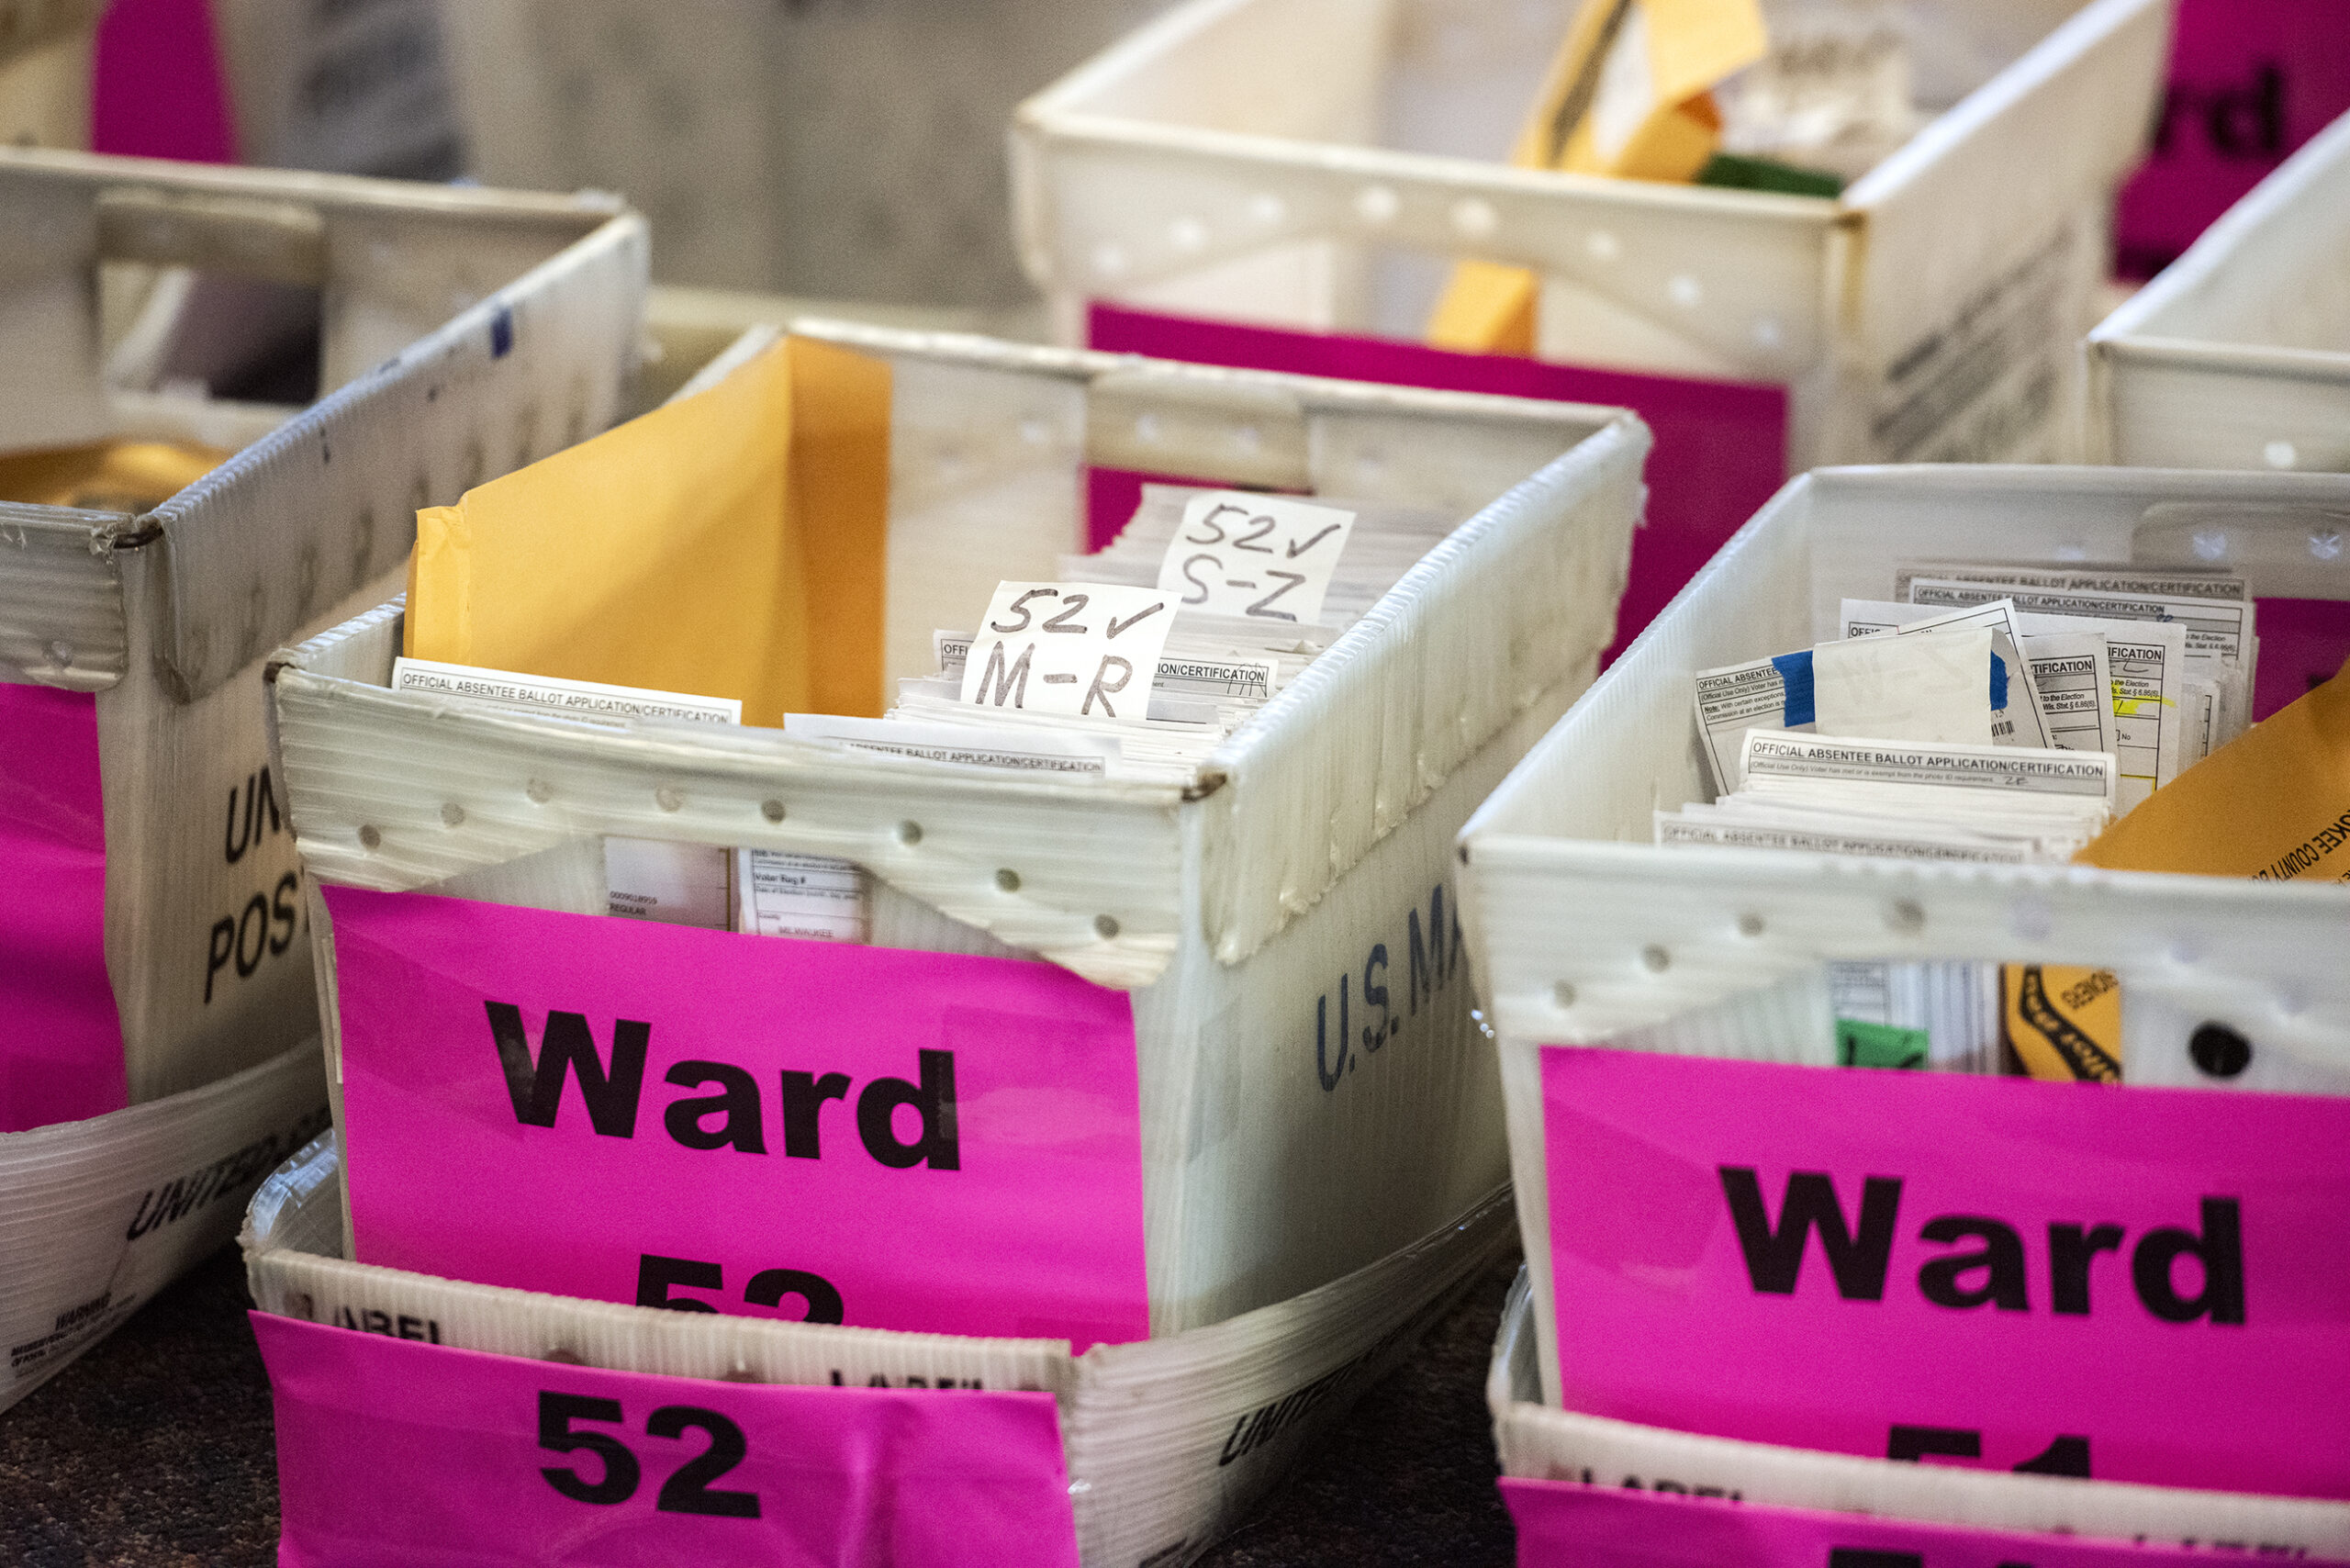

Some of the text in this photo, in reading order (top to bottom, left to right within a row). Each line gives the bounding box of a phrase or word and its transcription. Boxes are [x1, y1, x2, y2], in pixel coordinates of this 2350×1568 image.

[1185, 503, 1274, 554] 52
[1917, 586, 1955, 599] OFFICIAL
[990, 588, 1088, 633] 52
[974, 640, 1135, 719] M-R
[1698, 667, 1778, 689] OFFICIAL ABSENTEE
[2031, 660, 2093, 674] TIFICATION
[403, 672, 453, 690] OFFICIAL
[456, 680, 516, 699] ABSENTEE
[519, 689, 565, 704] BALLOT
[1751, 682, 1767, 691] Voter
[905, 747, 948, 761] BALLOT
[2121, 733, 2132, 741] No
[1752, 742, 2104, 777] OFFICIAL ABSENTEE BALLOT APPLICATION/CERTIFICATION
[1316, 944, 1399, 1092] U.S.
[484, 999, 962, 1171] Ward
[1717, 1163, 2247, 1327] Ward
[538, 1390, 762, 1519] 52
